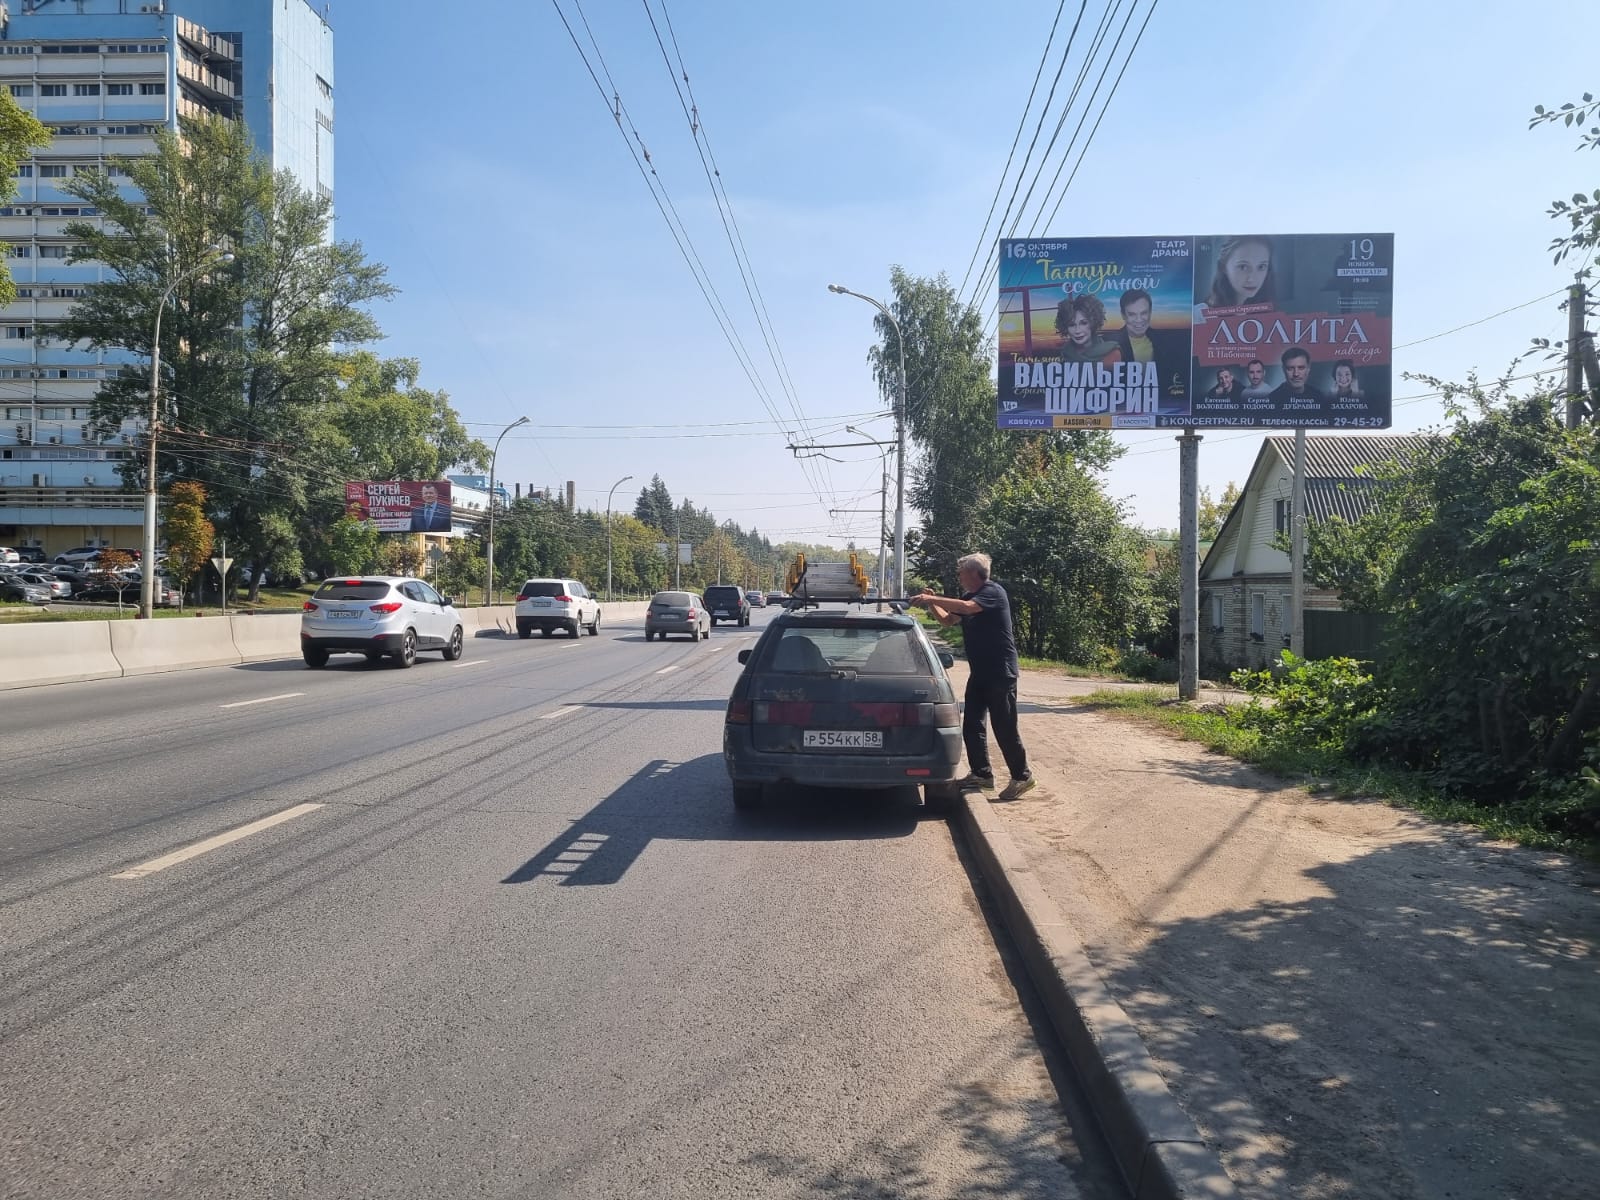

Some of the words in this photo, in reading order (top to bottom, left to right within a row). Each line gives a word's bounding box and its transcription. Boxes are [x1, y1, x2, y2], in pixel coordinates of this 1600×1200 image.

[1006, 243, 1026, 258] 16
[1152, 249, 1188, 258] ДРАМЫ
[1350, 239, 1373, 260] 19
[1036, 259, 1123, 294] Танцуй
[1062, 280, 1086, 294] со
[1102, 274, 1160, 292] мной
[1209, 318, 1368, 344] ЛОЛИТА
[1014, 361, 1159, 388] ВАСИЛЬЕВА
[1045, 387, 1159, 413] ШИФРИН
[1170, 417, 1254, 425] KONCERTPNZ.RU
[1334, 417, 1383, 426] 29-45-29
[367, 483, 400, 495] СЕРГЕЙ
[368, 495, 411, 506] ЛУКИЧЕВ
